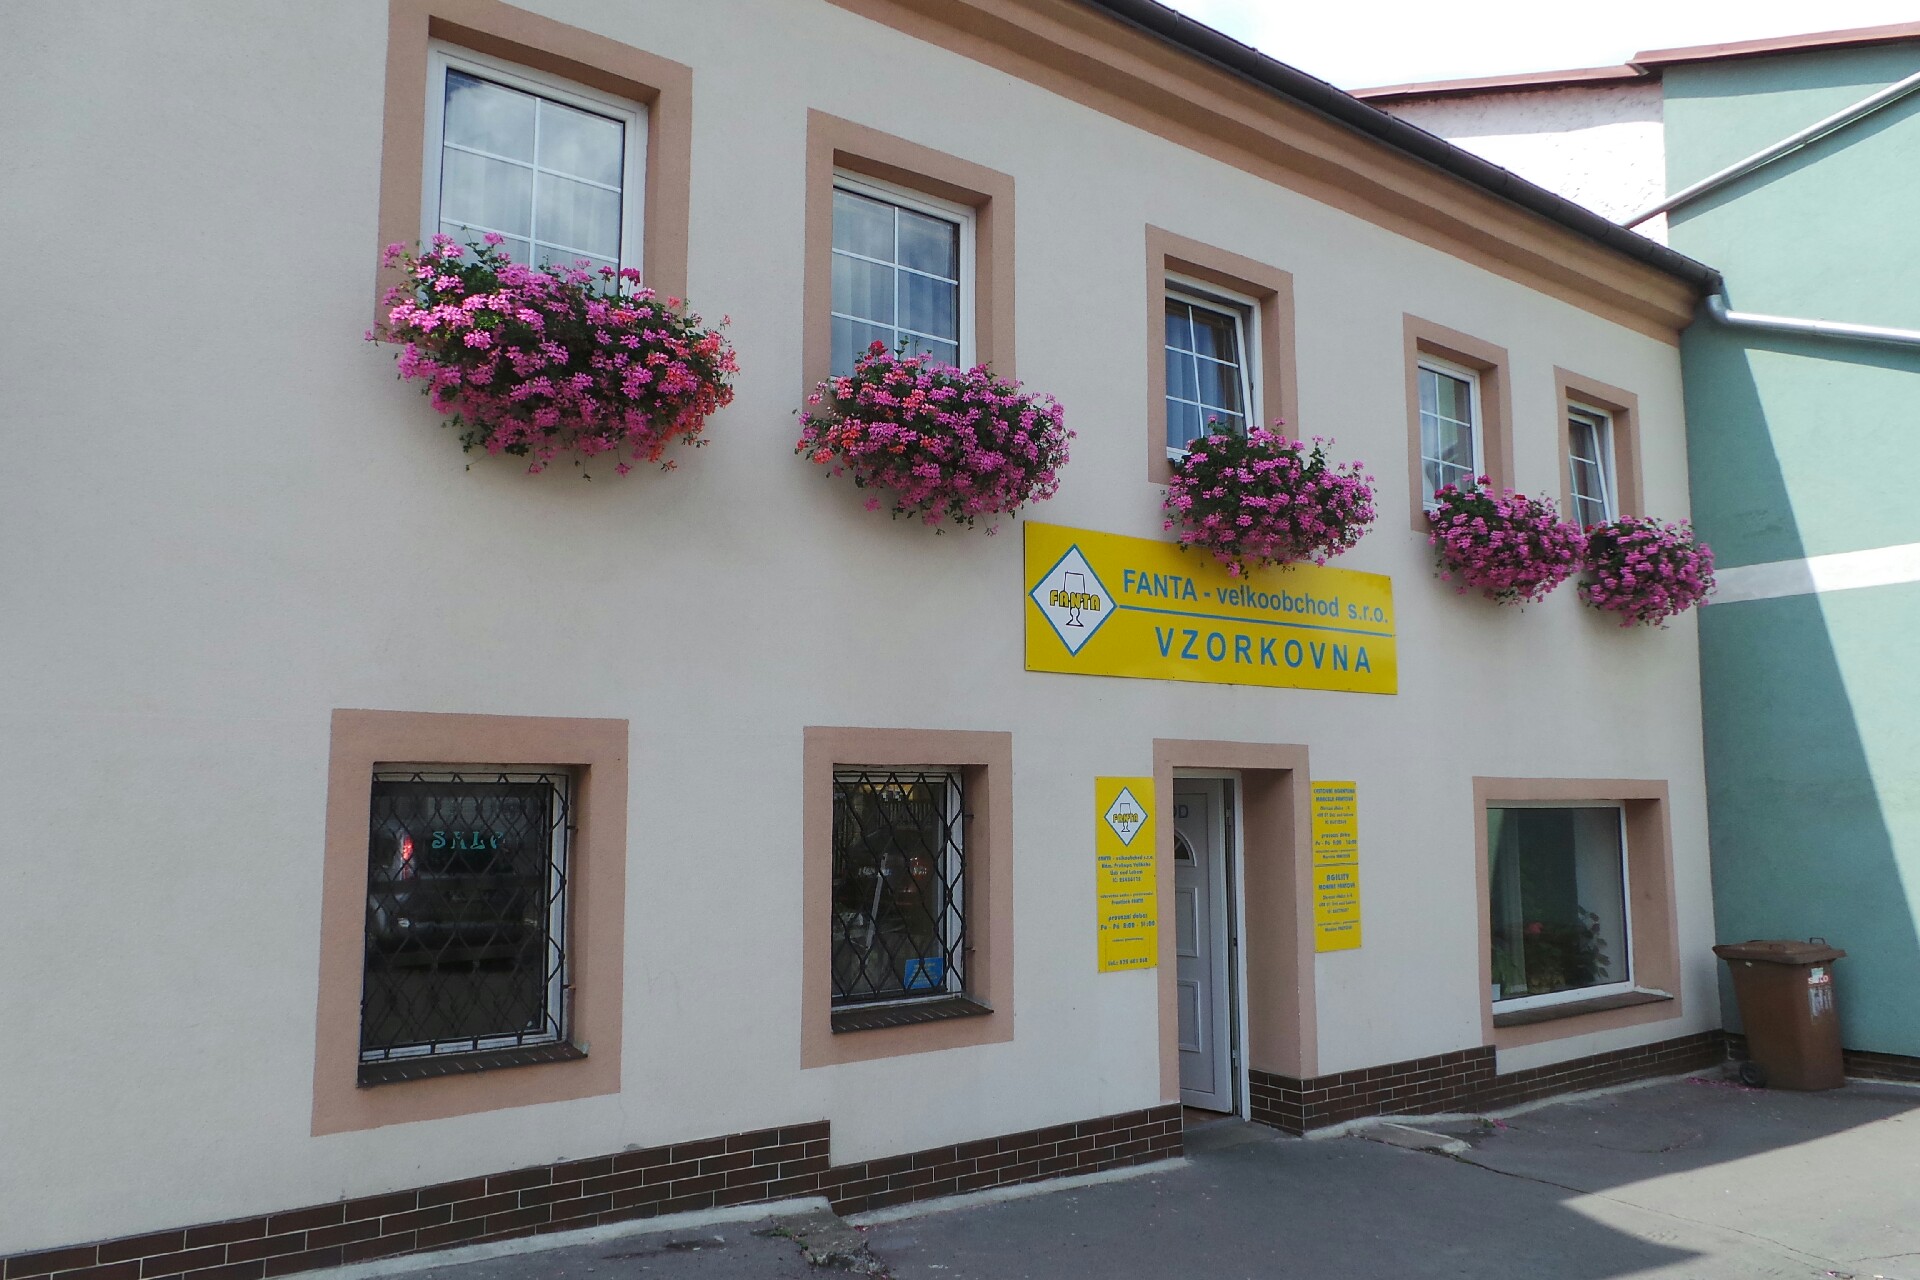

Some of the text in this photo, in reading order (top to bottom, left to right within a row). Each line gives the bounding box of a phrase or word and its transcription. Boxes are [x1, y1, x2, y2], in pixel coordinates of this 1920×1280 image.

[1049, 589, 1101, 612] FANTA
[1123, 569, 1198, 602] FANTA
[1216, 585, 1340, 618] velkoobchod
[1348, 603, 1389, 624] s.r.o.
[1155, 626, 1372, 673] VZORKOVNA
